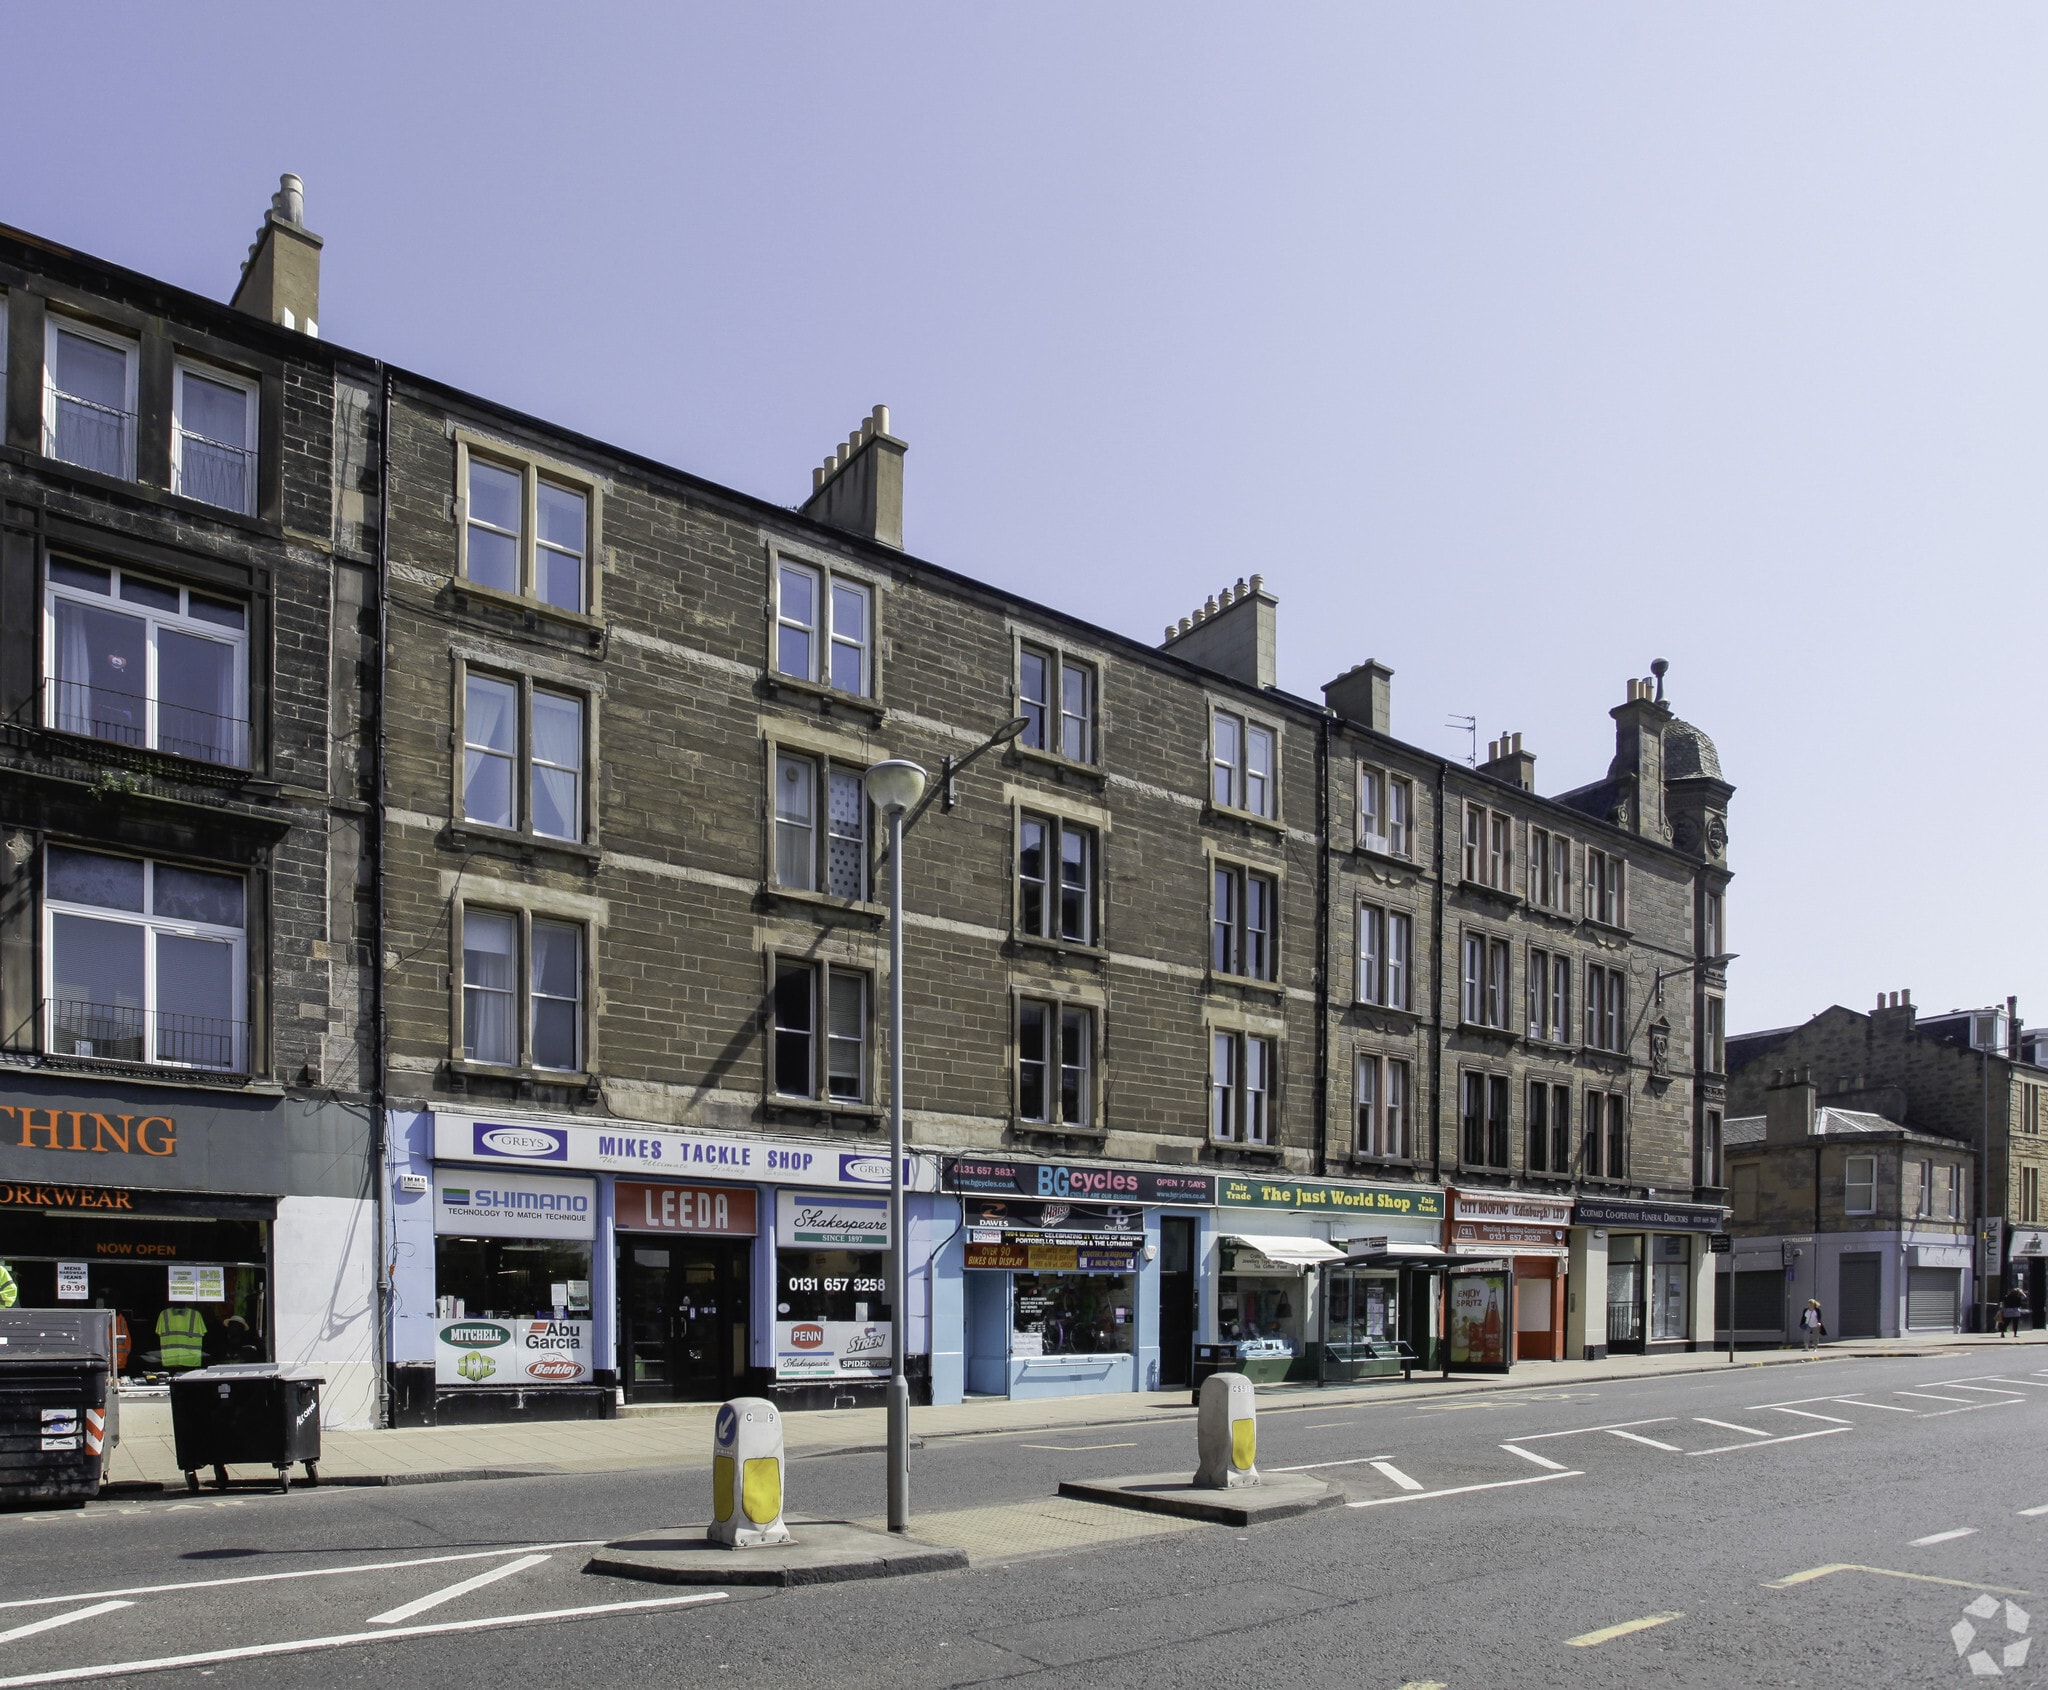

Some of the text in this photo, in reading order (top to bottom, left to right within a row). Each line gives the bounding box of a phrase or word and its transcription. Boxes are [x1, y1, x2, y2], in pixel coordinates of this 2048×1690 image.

[501, 1136, 544, 1148] GREYS
[598, 1136, 813, 1171] MIKES TACKLE SHOP
[859, 1165, 892, 1174] GREYS
[977, 1166, 992, 1175] 657
[1156, 1178, 1207, 1189] OPEN 7 DAYS
[1230, 1182, 1248, 1191] Fair
[475, 1189, 588, 1212] SHIMANO
[1226, 1191, 1252, 1200] Trade
[1261, 1186, 1411, 1213] The Just World Shop
[1421, 1196, 1435, 1204] Fair
[645, 1189, 728, 1229] LEEDA
[1417, 1203, 1438, 1212] Trade
[1460, 1201, 1565, 1221] CITY ROOFING (Edinburgh) LTD
[448, 1207, 587, 1222] TECHNOLOGY TO MATCH TECHNIQUE
[1580, 1207, 1604, 1218] SCOTMID
[1641, 1211, 1662, 1222] FUNERAL
[1663, 1212, 1689, 1223] DIRECTORS
[794, 1208, 887, 1234] Shakespeare
[979, 1219, 1009, 1227] DAWES
[1482, 1225, 1501, 1234] Roofing
[1505, 1226, 1524, 1235] Building
[1524, 1227, 1552, 1235] Contractors
[822, 1234, 863, 1243] SINCE 1897
[96, 1243, 177, 1256] NOW OPEN
[981, 1246, 1011, 1256] OVER 90
[968, 1256, 1025, 1267] BIKES ON DISPLAY
[60, 1284, 87, 1292] £9.99
[788, 1277, 886, 1292] 0131 657 3258
[1458, 1288, 1481, 1299] ENJOY
[1456, 1299, 1482, 1307] SPRITZ
[450, 1328, 501, 1341] MITCHELL
[546, 1322, 580, 1336] Abu
[793, 1330, 822, 1342] PENN
[525, 1335, 581, 1350] Garcia
[846, 1333, 886, 1354] STREN
[782, 1357, 830, 1369] Shakespeare
[533, 1363, 579, 1379] Berkley
